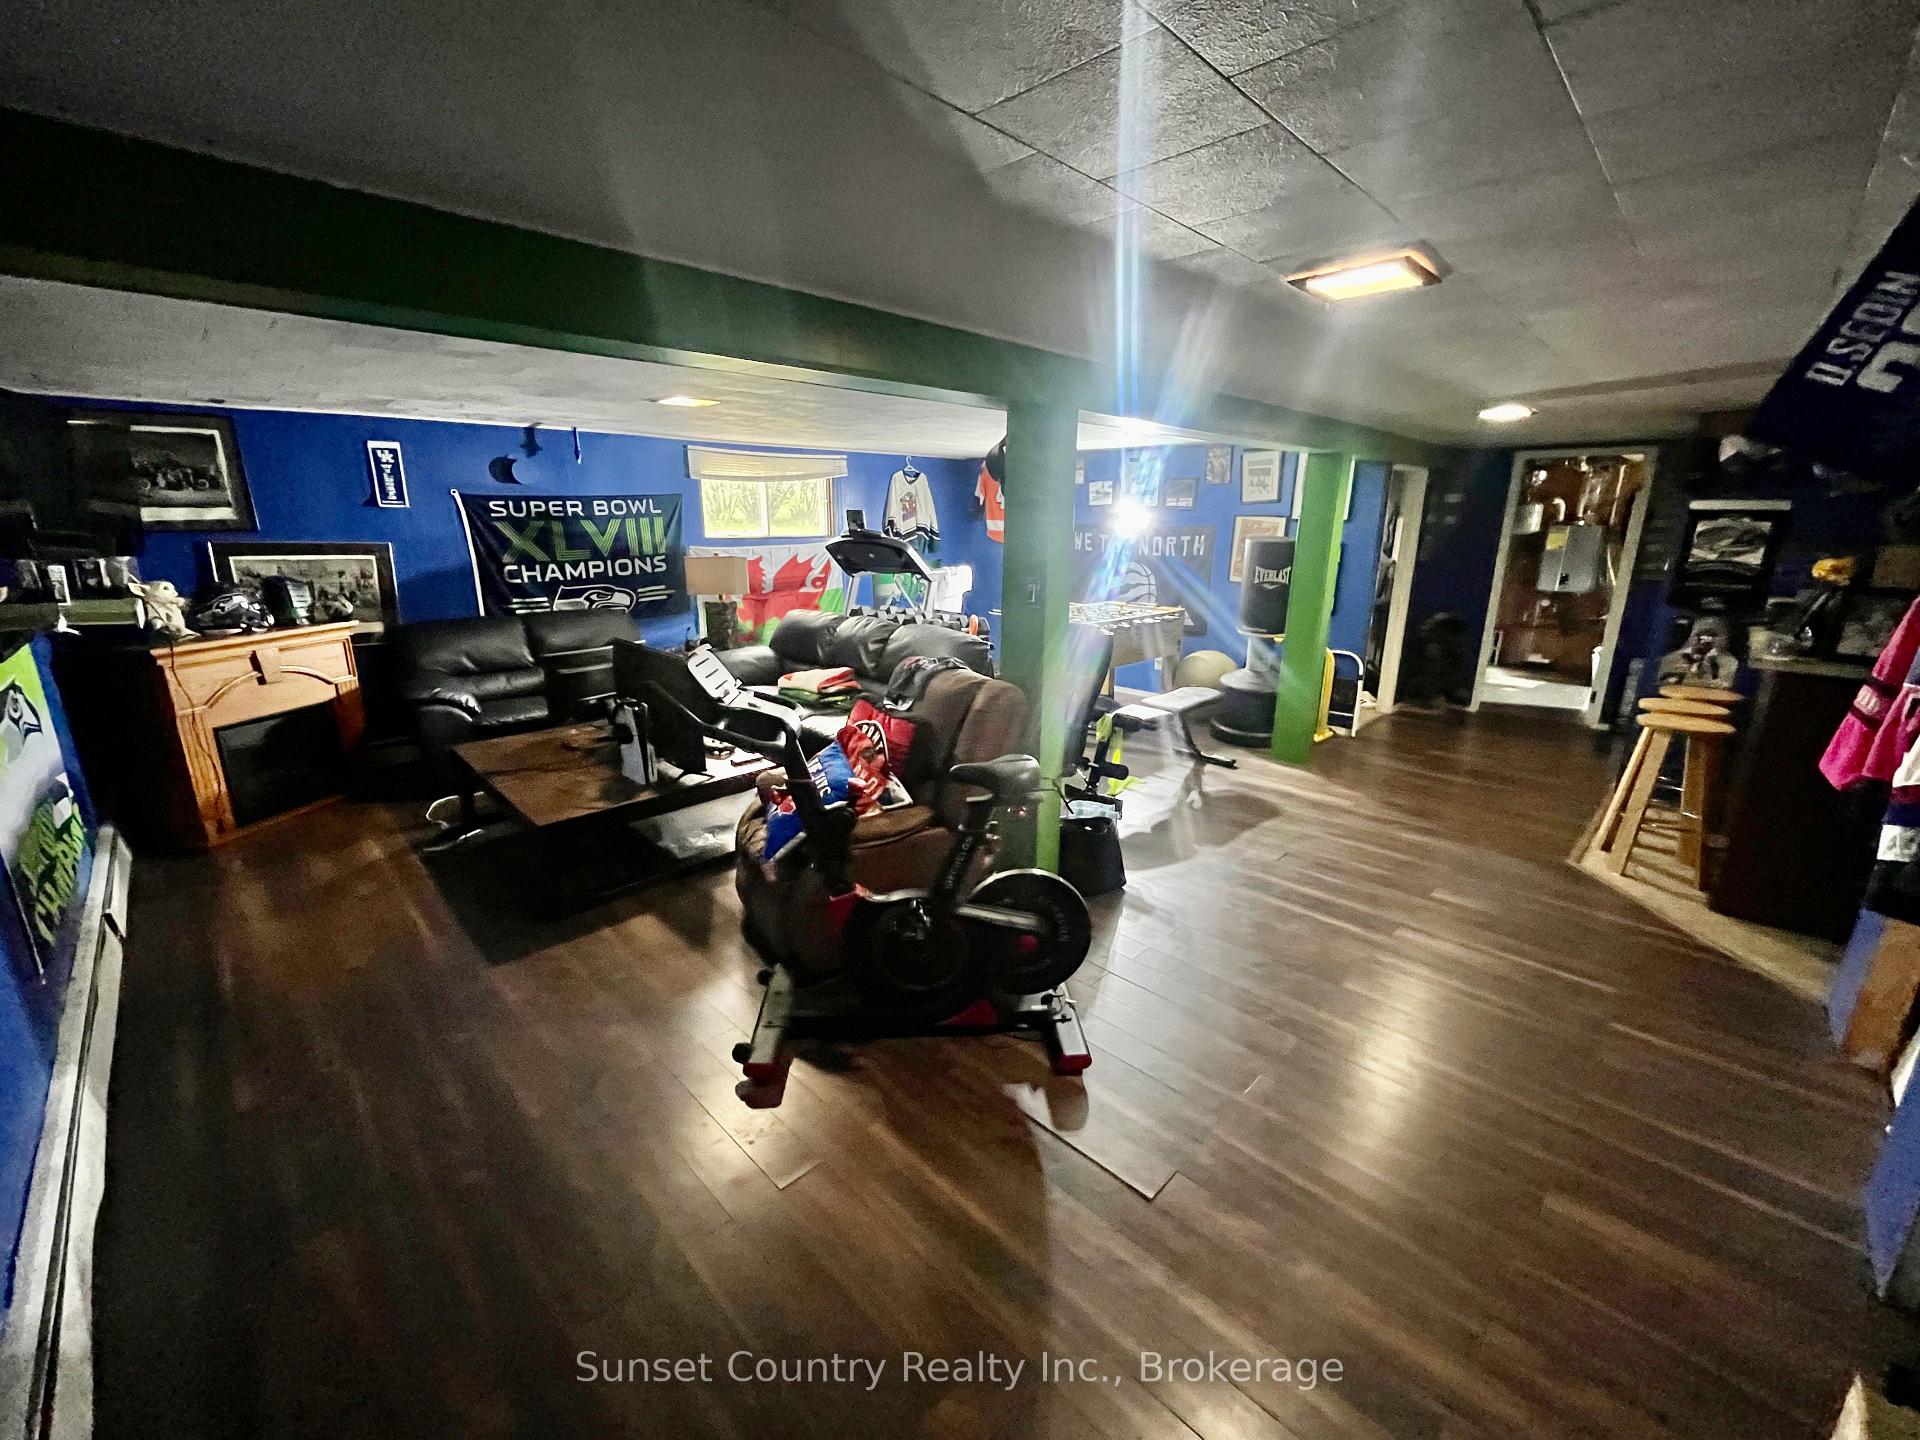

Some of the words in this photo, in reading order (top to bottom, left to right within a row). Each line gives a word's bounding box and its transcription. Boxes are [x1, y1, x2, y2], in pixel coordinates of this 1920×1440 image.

[488, 500, 585, 517] SUPER
[593, 498, 663, 517] BOWL
[492, 516, 668, 564] XLVIII
[1074, 531, 1093, 551] WE
[1138, 534, 1206, 558] NORTH
[502, 555, 668, 584] CHAMPIONS
[1253, 565, 1292, 585] EVERLAST
